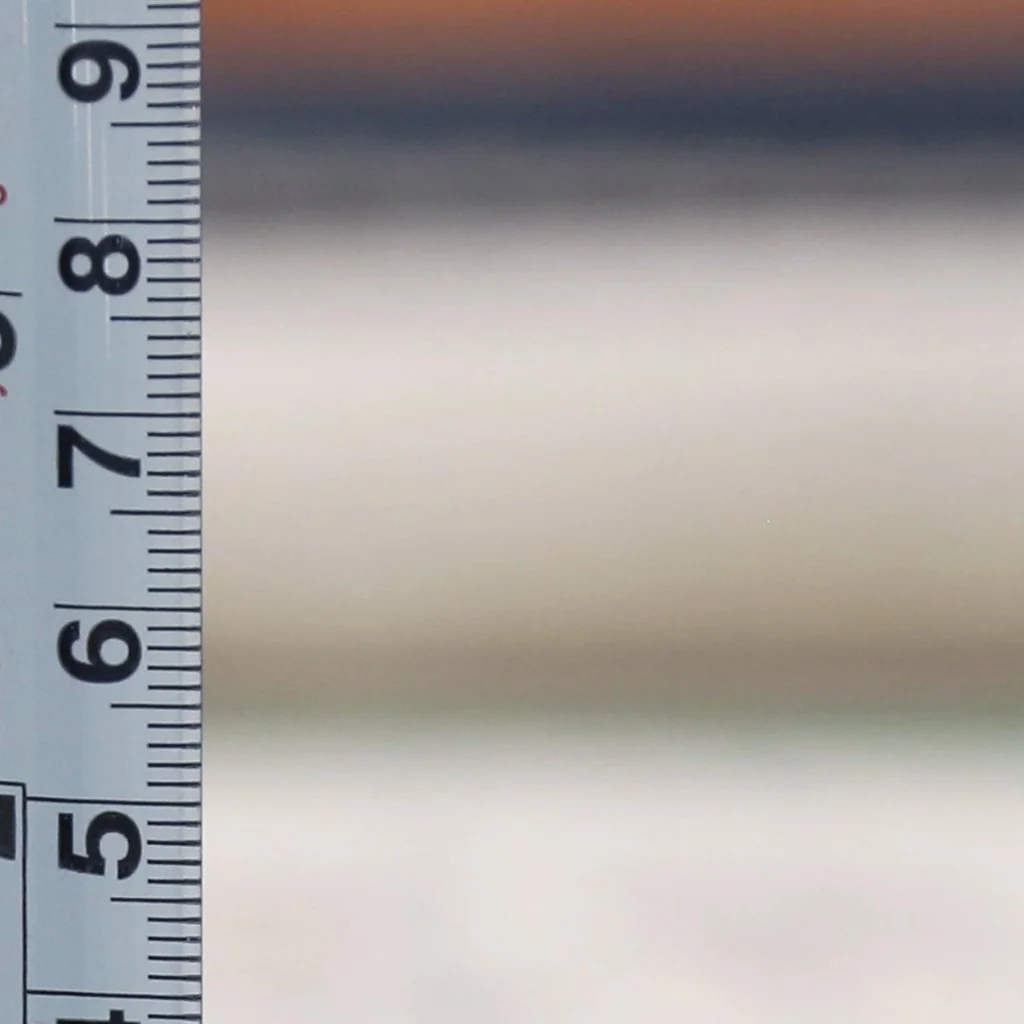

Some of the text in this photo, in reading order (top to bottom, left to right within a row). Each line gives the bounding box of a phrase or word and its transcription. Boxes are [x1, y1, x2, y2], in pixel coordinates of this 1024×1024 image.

[58, 40, 141, 103] 9
[58, 234, 141, 296] 8
[57, 424, 141, 488] 7
[57, 619, 142, 684] 6
[57, 811, 142, 880] 5
